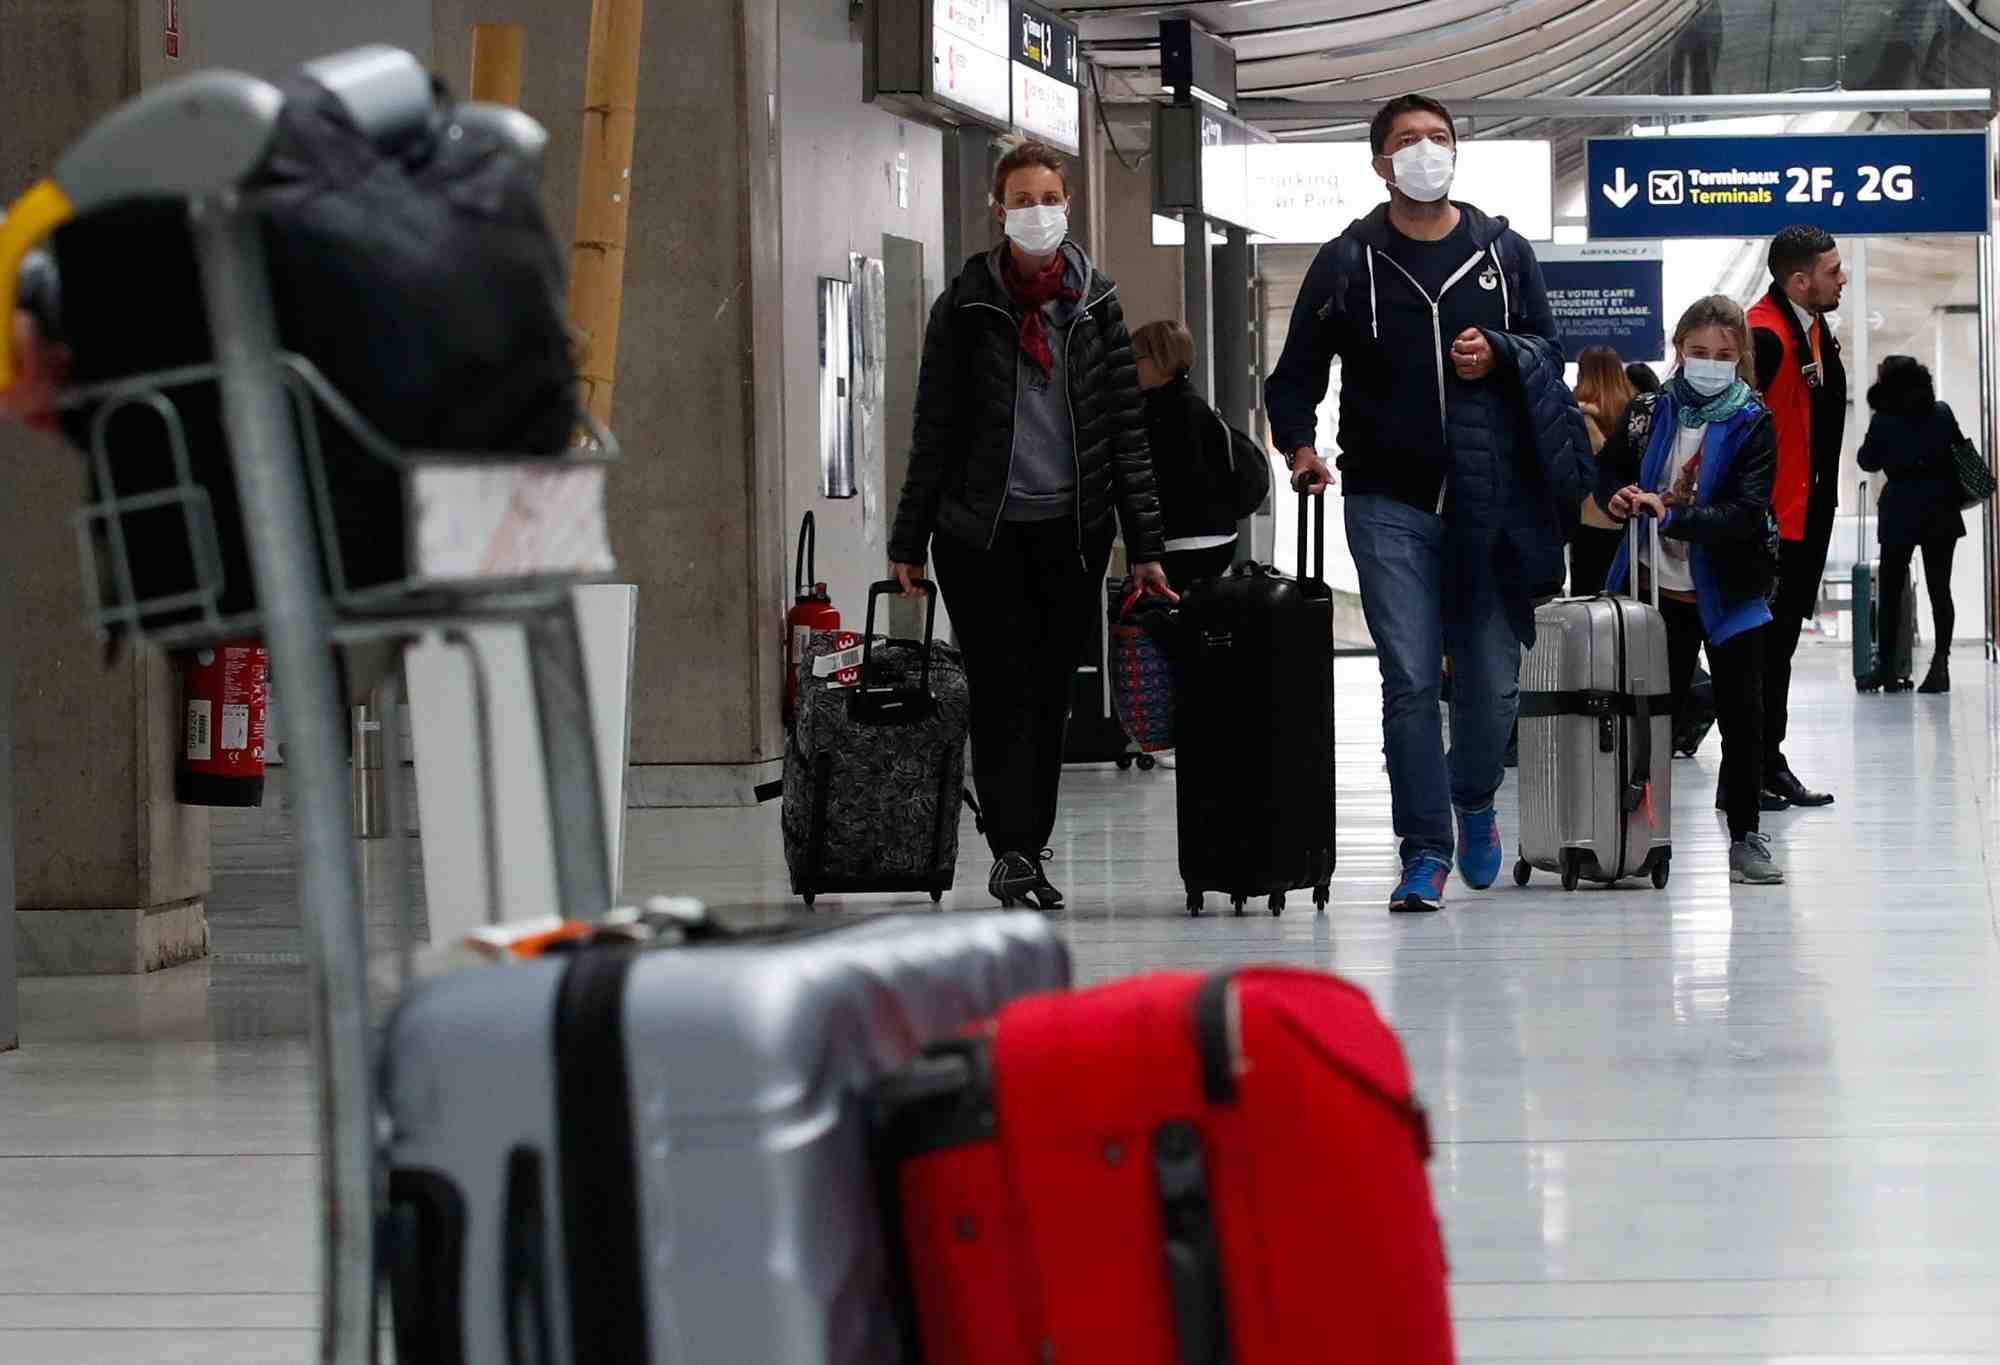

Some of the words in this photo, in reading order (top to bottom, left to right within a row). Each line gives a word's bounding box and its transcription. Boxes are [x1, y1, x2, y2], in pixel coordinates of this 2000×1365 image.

[1688, 169, 1780, 185] Terminaux
[1786, 167, 1844, 207] 2F,
[1857, 165, 1914, 201] 2G
[1689, 188, 1772, 204] Terminals
[1567, 289, 1600, 298] VOTRE
[1602, 289, 1635, 298] CARTE
[1611, 299, 1624, 307] ET
